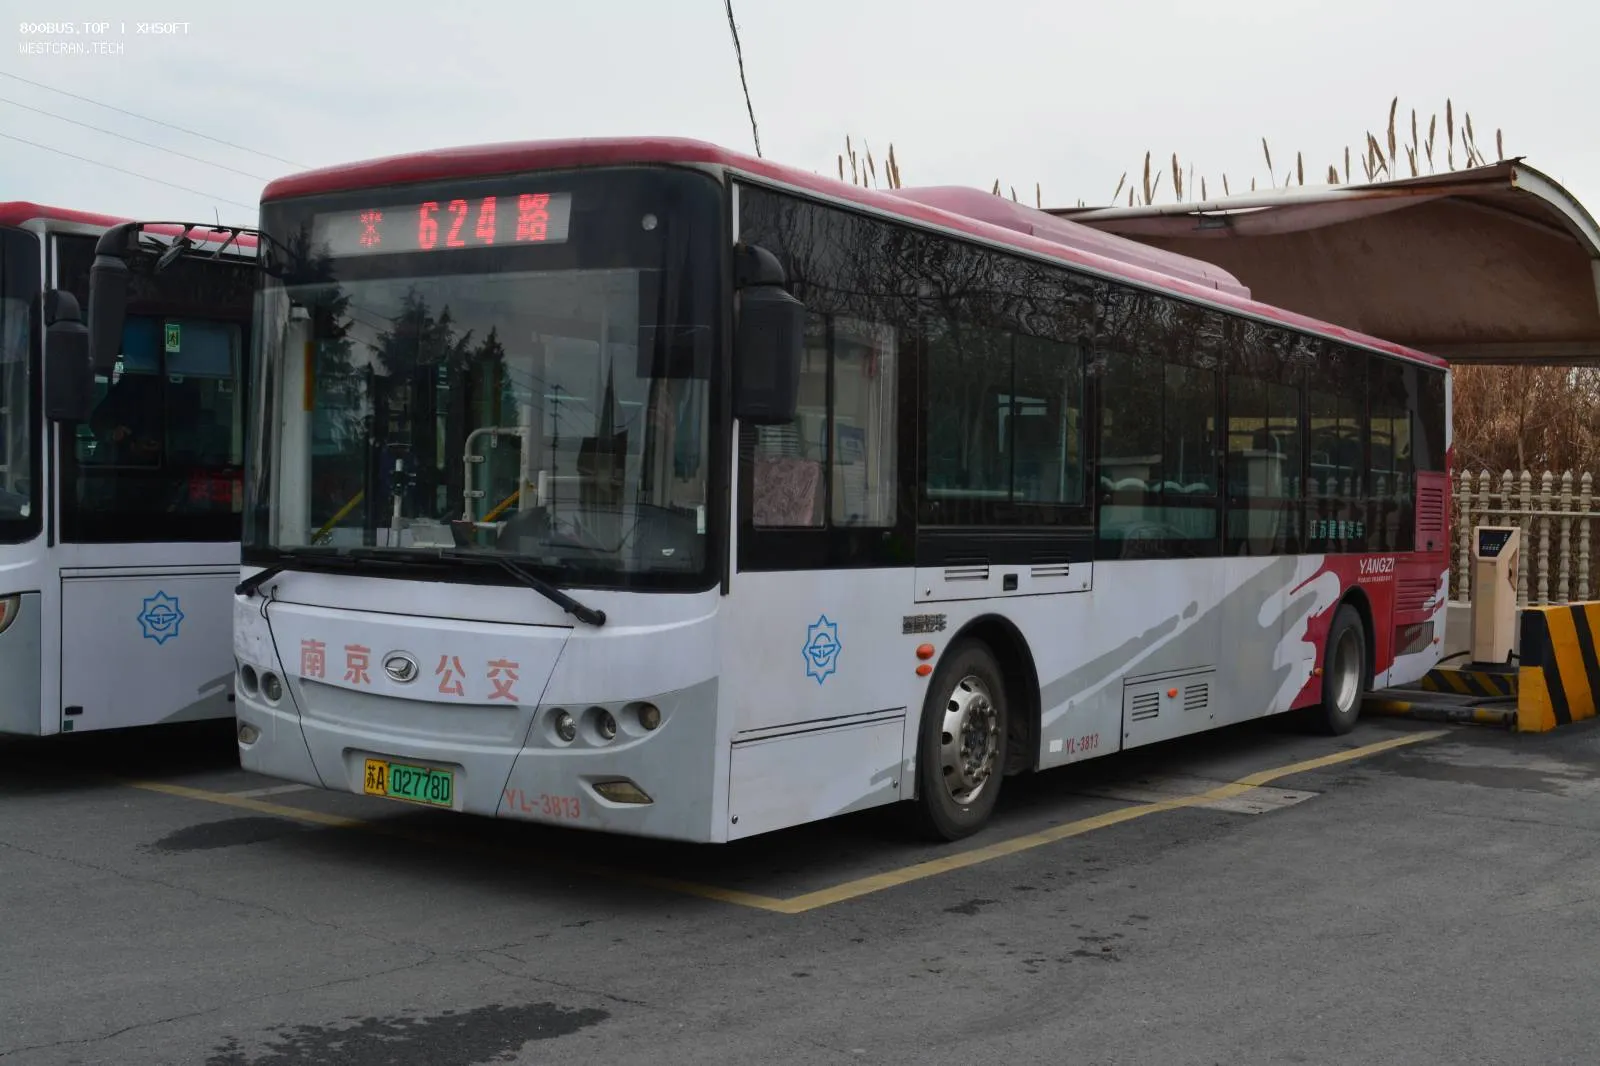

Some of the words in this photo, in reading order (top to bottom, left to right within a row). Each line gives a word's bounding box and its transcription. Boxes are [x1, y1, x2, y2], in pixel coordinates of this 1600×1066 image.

[1359, 557, 1395, 575] YANGZI
[301, 638, 371, 685] 南京
[435, 654, 520, 702] 公交
[1065, 732, 1099, 755] YL-3813
[504, 788, 581, 819] YL-3813
